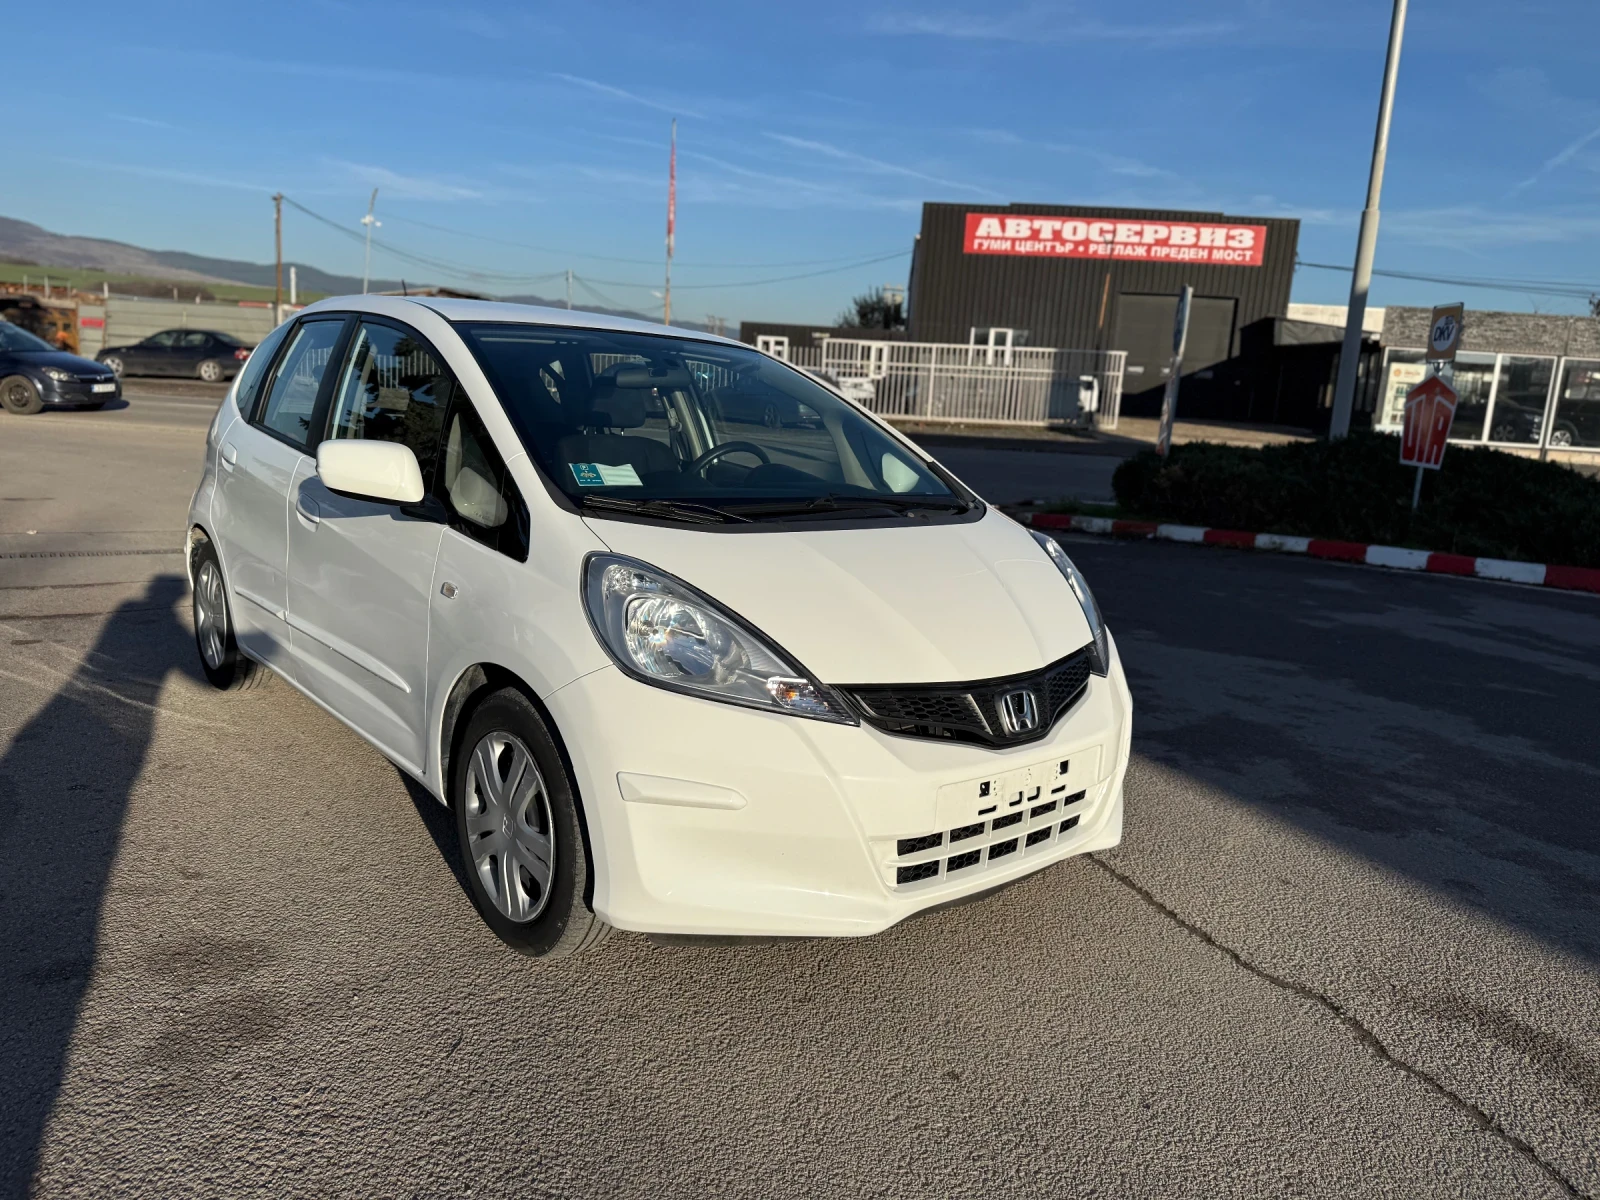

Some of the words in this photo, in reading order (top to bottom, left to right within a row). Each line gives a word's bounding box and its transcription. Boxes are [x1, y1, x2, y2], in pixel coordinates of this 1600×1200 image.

[975, 218, 1254, 249] АВТОСЕРВИЗ
[973, 239, 1011, 250] ГУМИ
[1014, 241, 1073, 253] ЦЕНТЪР
[1088, 244, 1147, 256] РЕГЛАЖ
[1150, 246, 1209, 260] ПРЕДЕН
[1211, 249, 1253, 261] МОСТ
[1433, 325, 1455, 342] DKV
